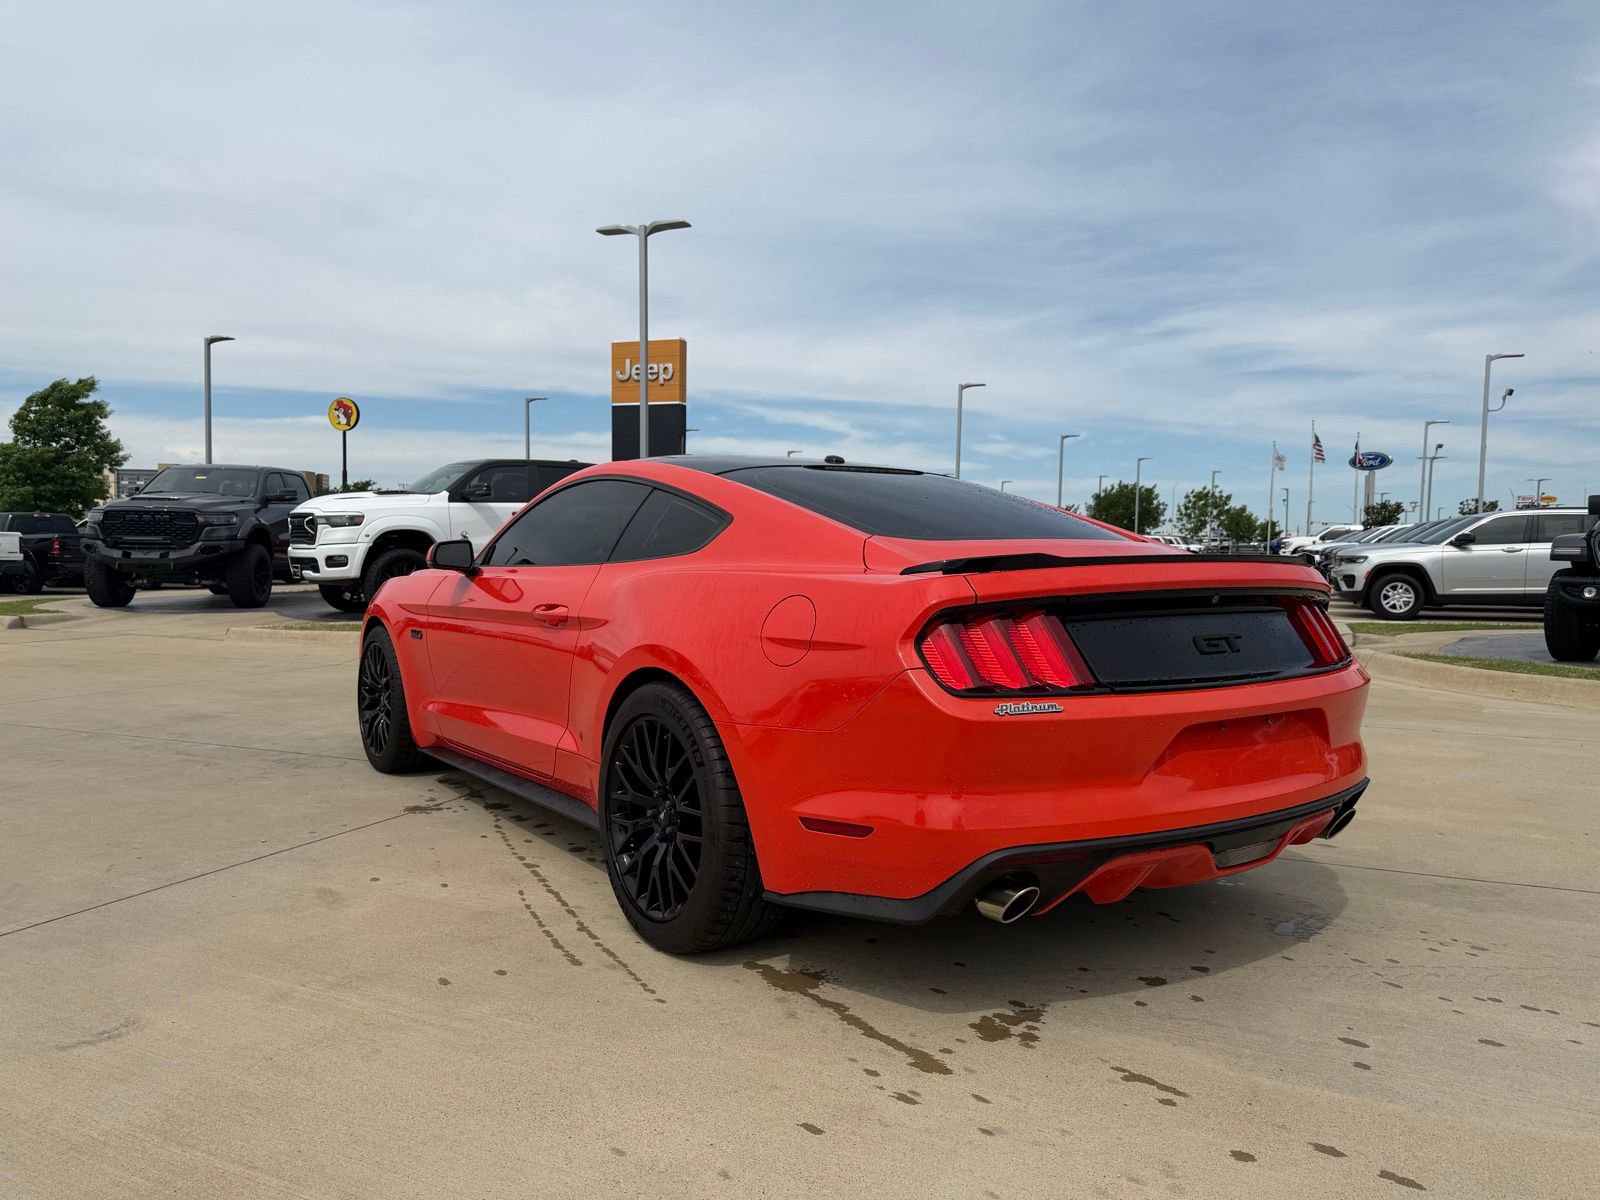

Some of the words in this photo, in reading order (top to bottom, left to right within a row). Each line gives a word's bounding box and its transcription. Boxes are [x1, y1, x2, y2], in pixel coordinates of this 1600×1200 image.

[615, 358, 674, 385] Jeep
[1191, 632, 1242, 656] GT
[994, 702, 1064, 716] Platinum
[662, 700, 705, 768] MICHELIN
